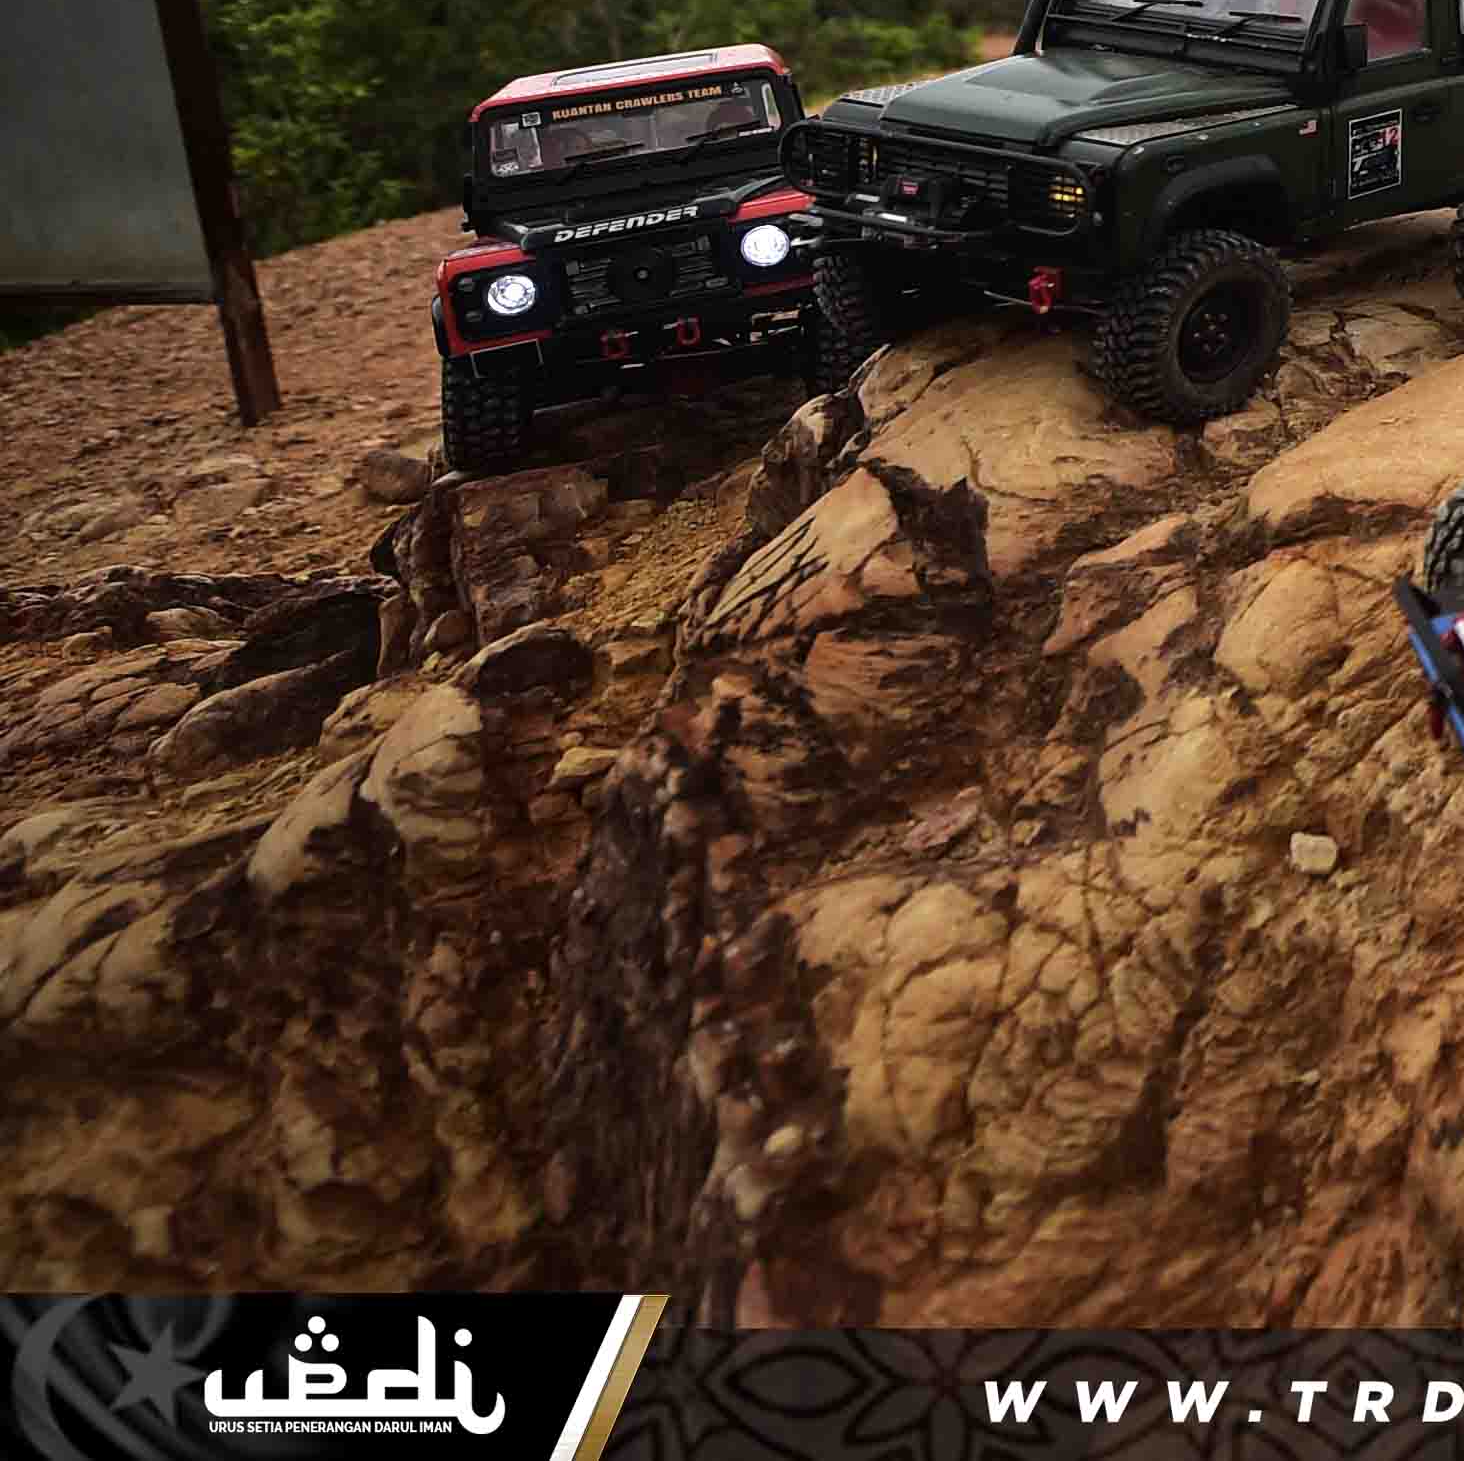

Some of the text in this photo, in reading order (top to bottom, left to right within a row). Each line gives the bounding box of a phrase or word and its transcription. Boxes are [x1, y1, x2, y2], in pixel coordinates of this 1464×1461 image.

[552, 84, 722, 121] KUANTAN CRAWLERS TEAM
[553, 205, 699, 244] DEFENDER
